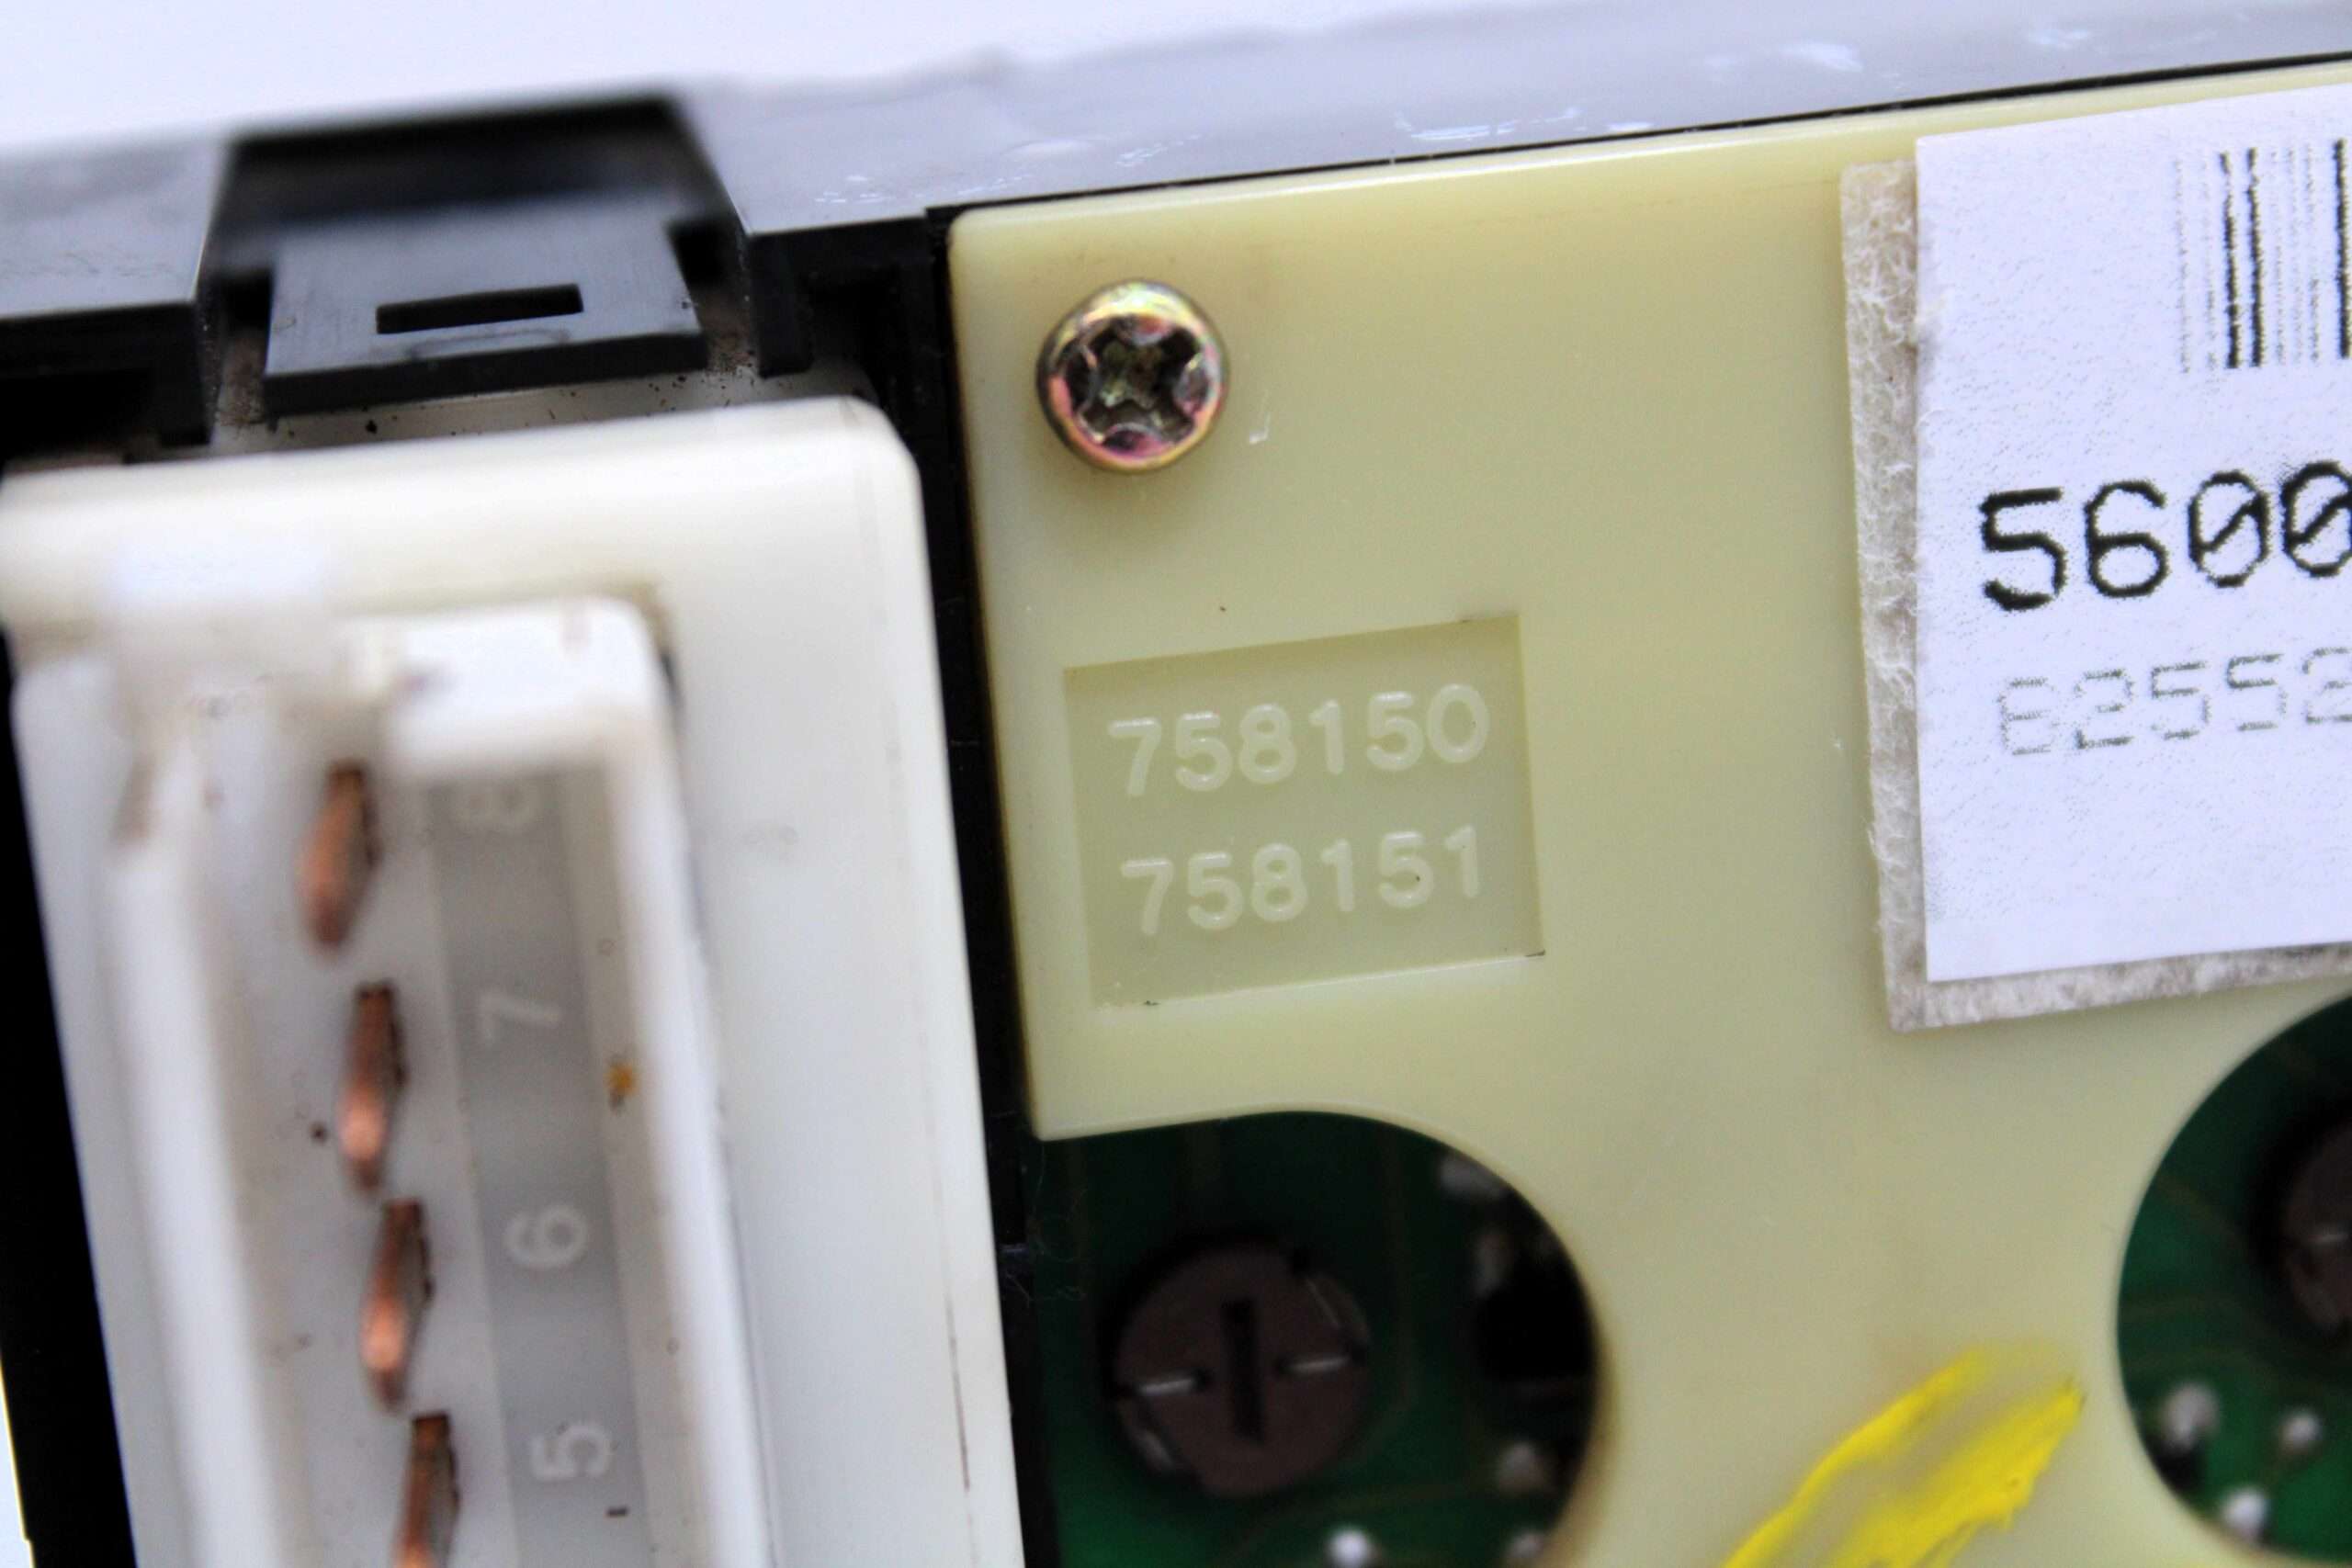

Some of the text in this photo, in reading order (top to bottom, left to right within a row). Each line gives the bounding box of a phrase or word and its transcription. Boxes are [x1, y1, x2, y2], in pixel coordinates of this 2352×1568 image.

[1107, 682, 1491, 797] 758150
[1120, 824, 1481, 937] 758151
[478, 992, 563, 1050] 7
[530, 1423, 614, 1482] 5
